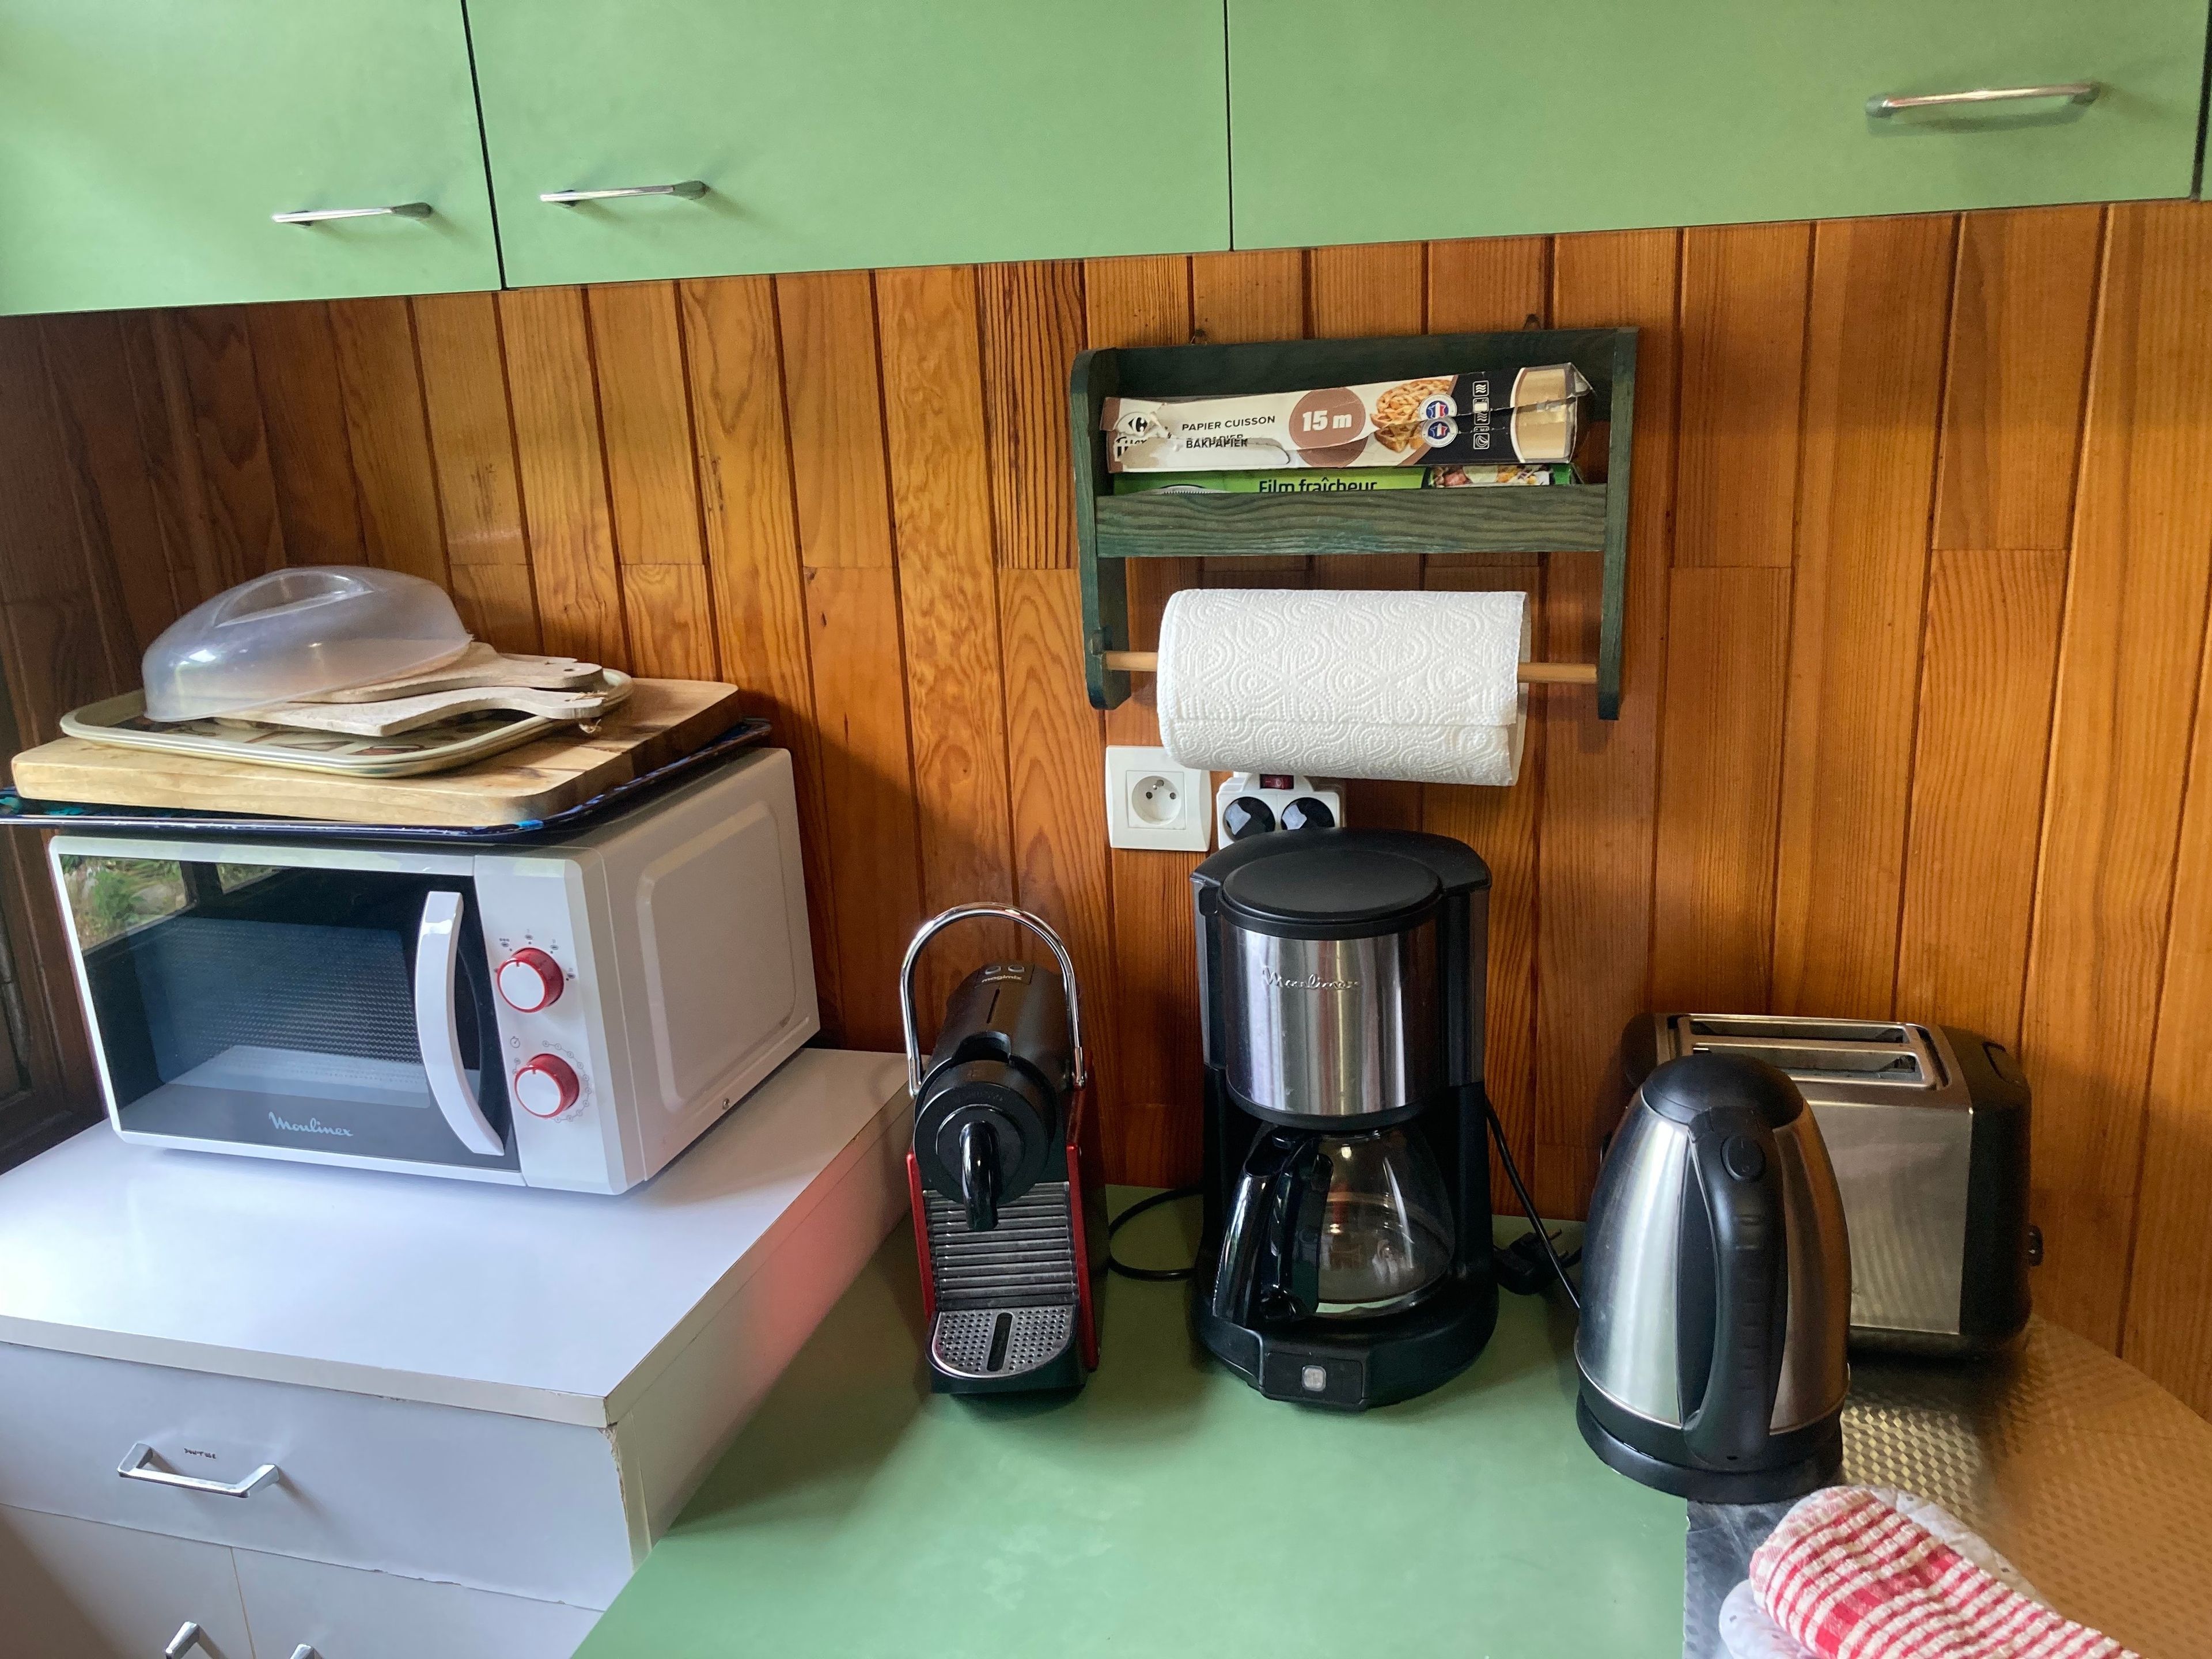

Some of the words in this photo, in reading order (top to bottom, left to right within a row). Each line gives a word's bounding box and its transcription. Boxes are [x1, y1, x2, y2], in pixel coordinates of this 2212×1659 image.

[1181, 421, 1221, 431] PAPIER
[1225, 415, 1275, 428] CUISSON
[1302, 410, 1328, 432] 15
[1332, 414, 1353, 429] m
[1259, 479, 1295, 493] Film
[1298, 476, 1378, 493] fraîcheur
[982, 975, 1022, 983] magimix
[268, 1111, 354, 1137] Moulinex
